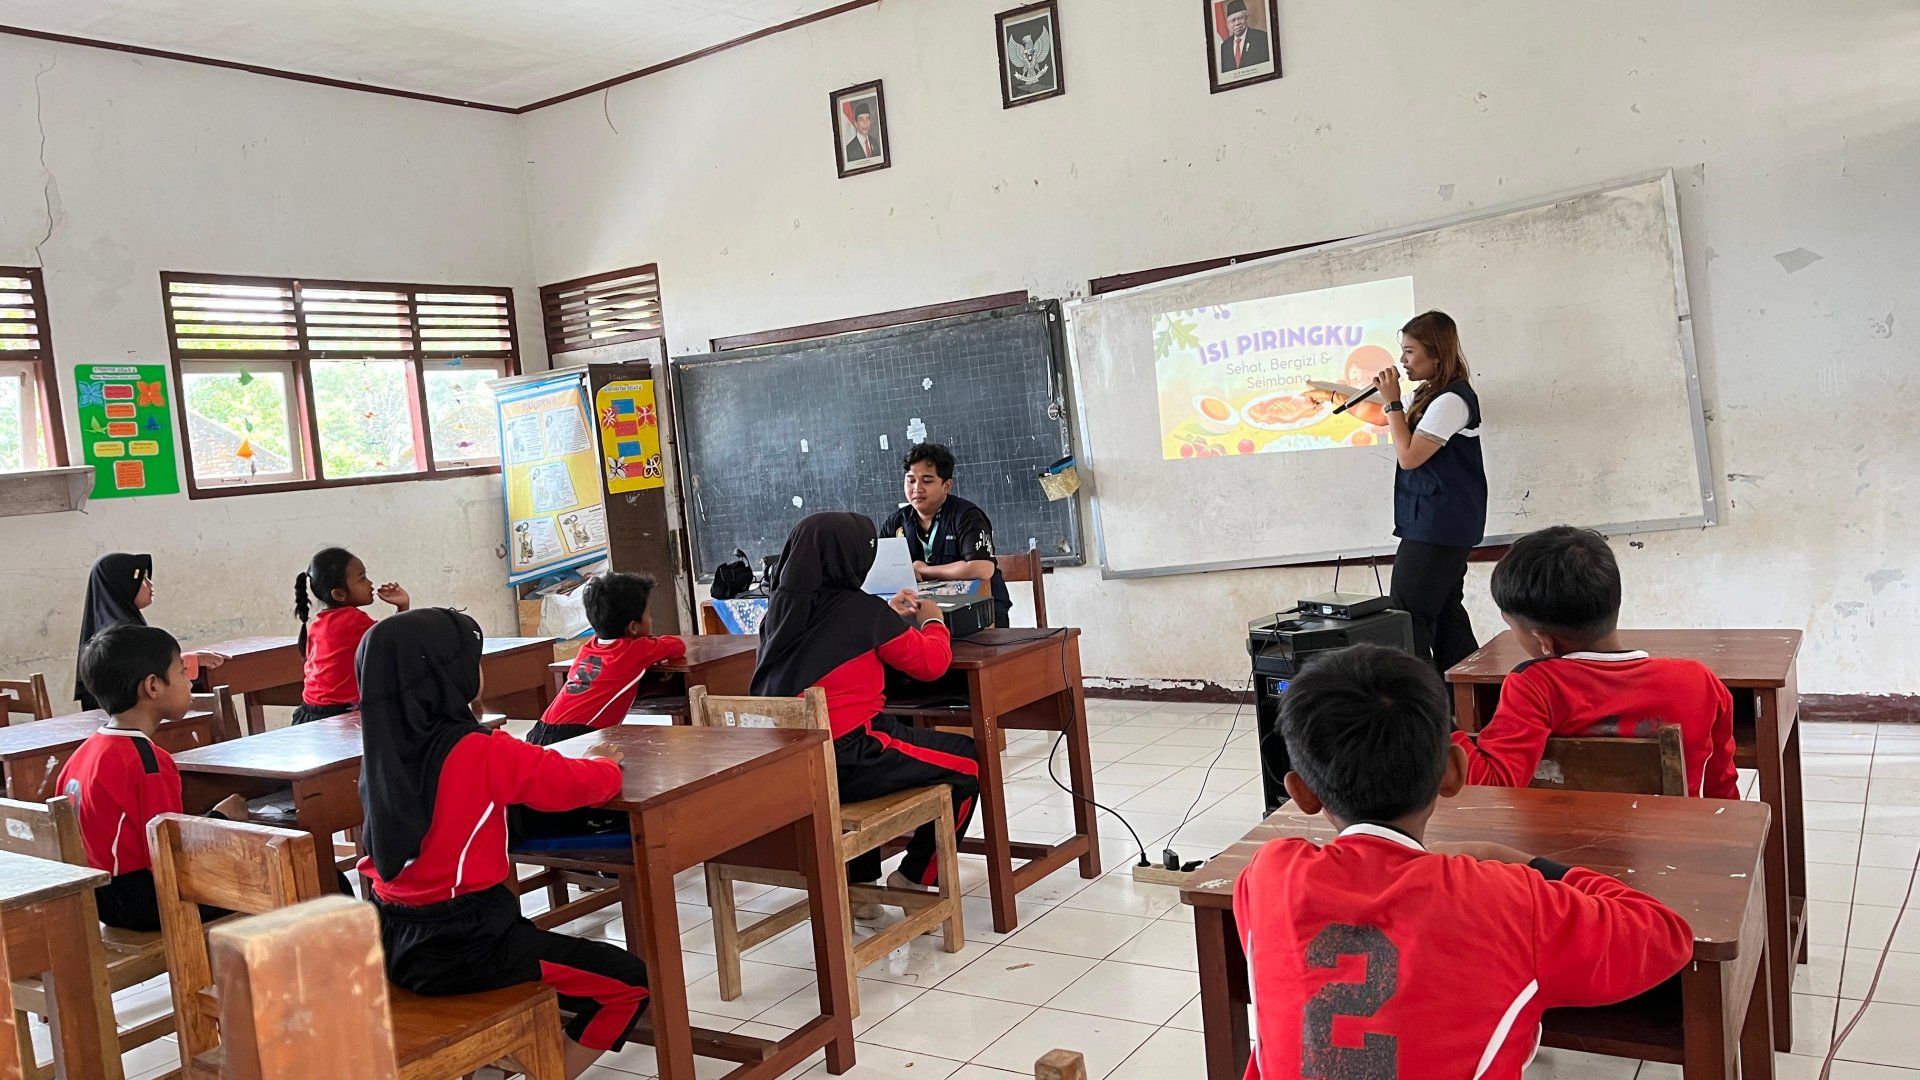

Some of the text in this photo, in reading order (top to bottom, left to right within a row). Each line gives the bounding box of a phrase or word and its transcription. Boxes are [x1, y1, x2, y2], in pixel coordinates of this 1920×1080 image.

[1199, 325, 1363, 365] ISI PIRINGKU
[1226, 352, 1333, 376] Sehat, Bergizi &
[1301, 922, 1399, 1080] 2
